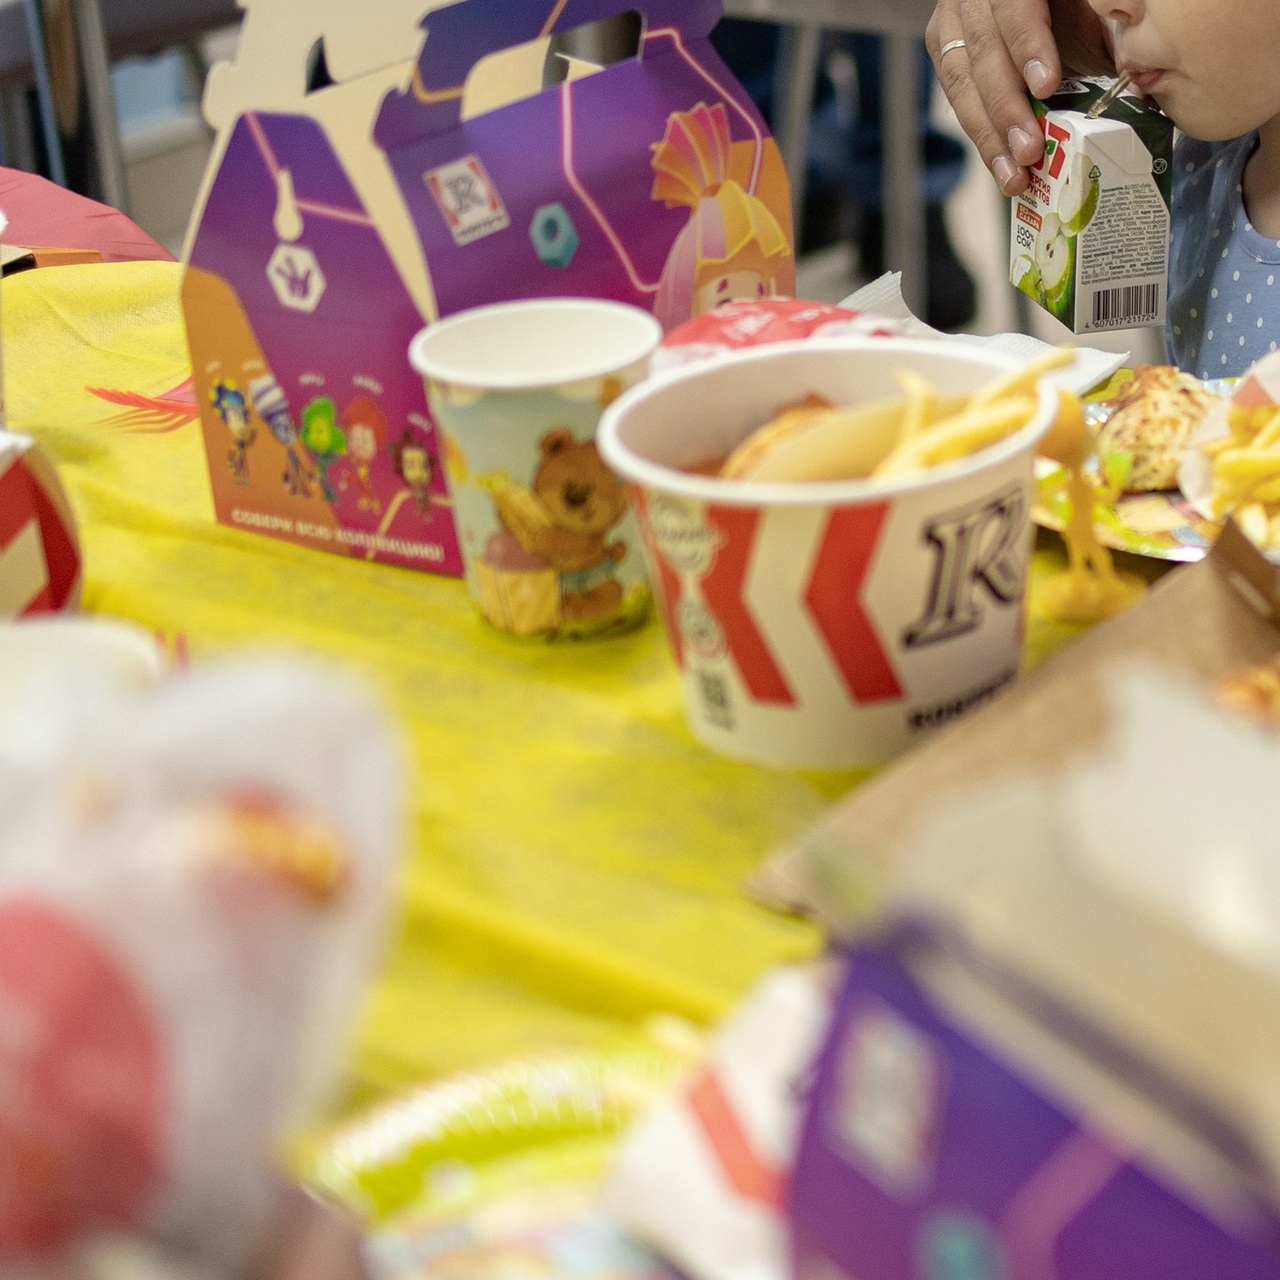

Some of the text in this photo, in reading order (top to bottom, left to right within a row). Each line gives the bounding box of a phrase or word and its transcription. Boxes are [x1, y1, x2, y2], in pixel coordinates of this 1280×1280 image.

[1029, 173, 1051, 195] ЕРГИЯ
[1027, 183, 1050, 206] УКТОВ
[1017, 224, 1035, 242] 100%
[1017, 235, 1031, 251] СОК
[1094, 318, 1123, 328] 607017
[1126, 314, 1155, 324] 211724
[902, 482, 1028, 650] R
